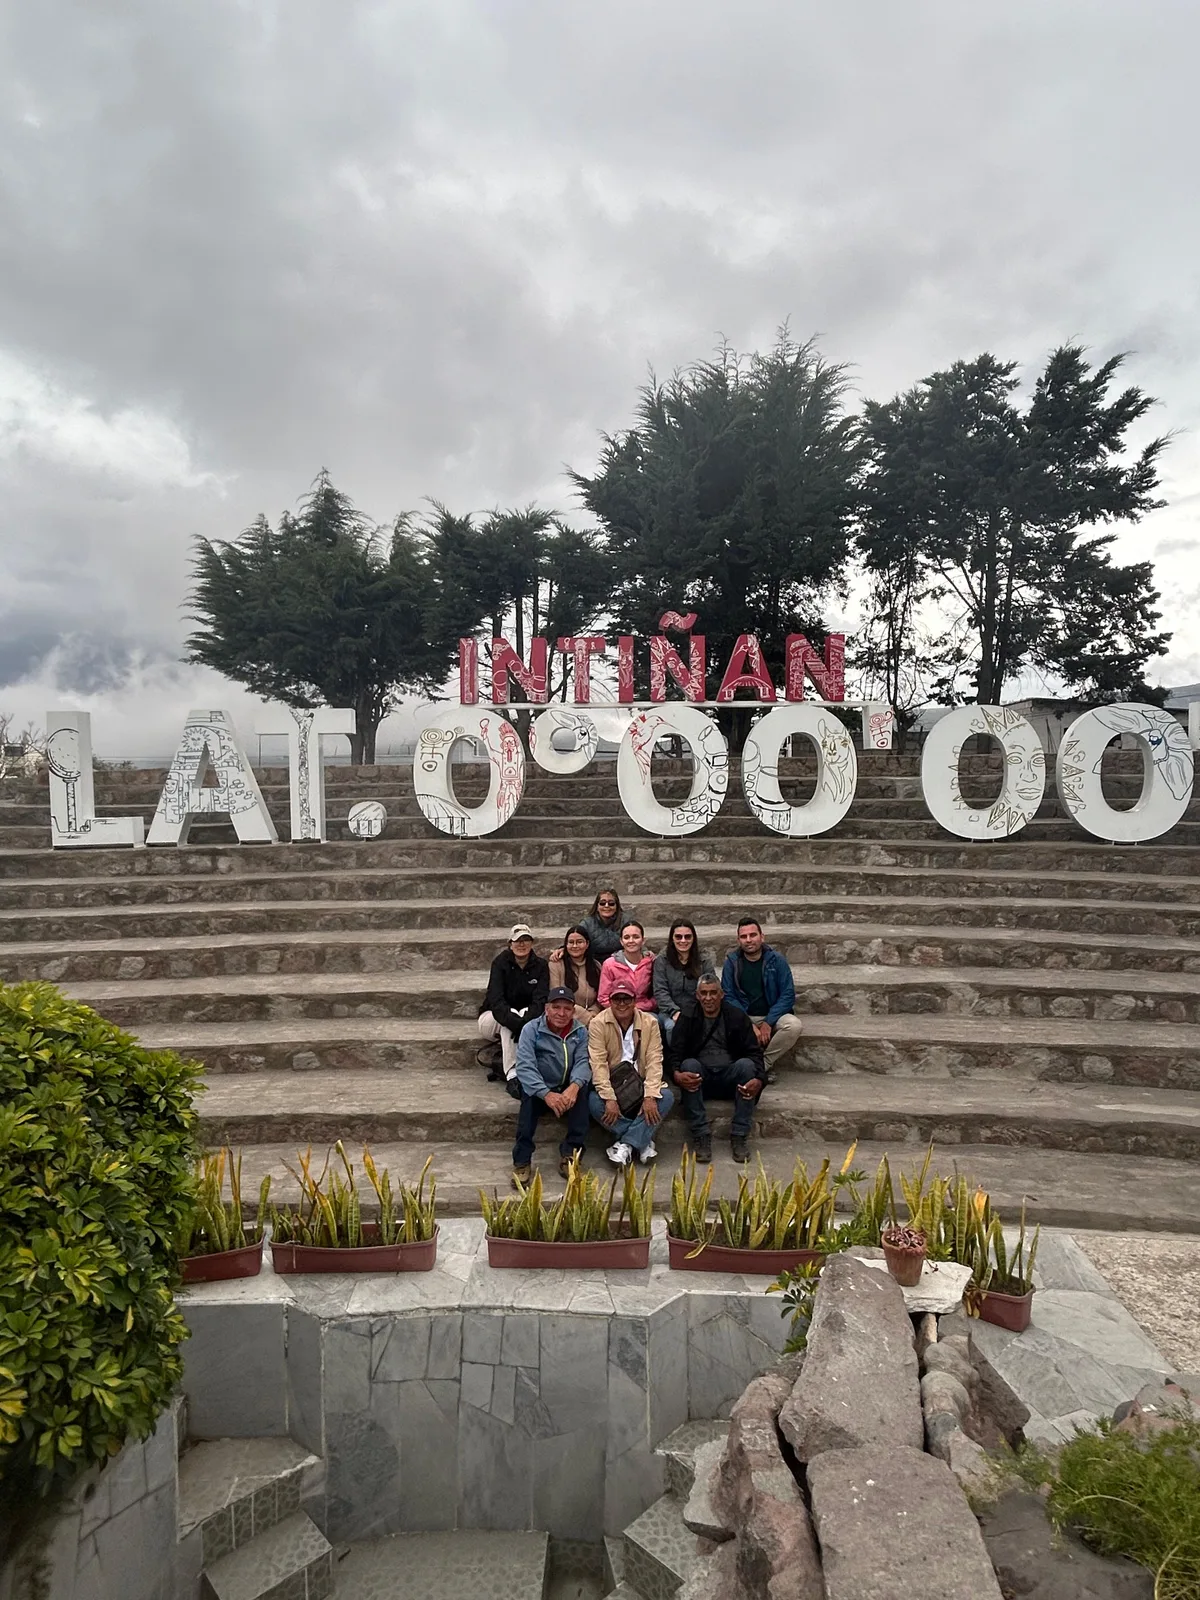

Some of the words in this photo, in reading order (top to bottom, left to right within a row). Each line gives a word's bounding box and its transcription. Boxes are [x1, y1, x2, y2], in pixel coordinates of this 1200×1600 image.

[460, 612, 845, 705] INTIÑAN
[46, 709, 386, 847] LAT.
[921, 703, 1200, 842] 00
